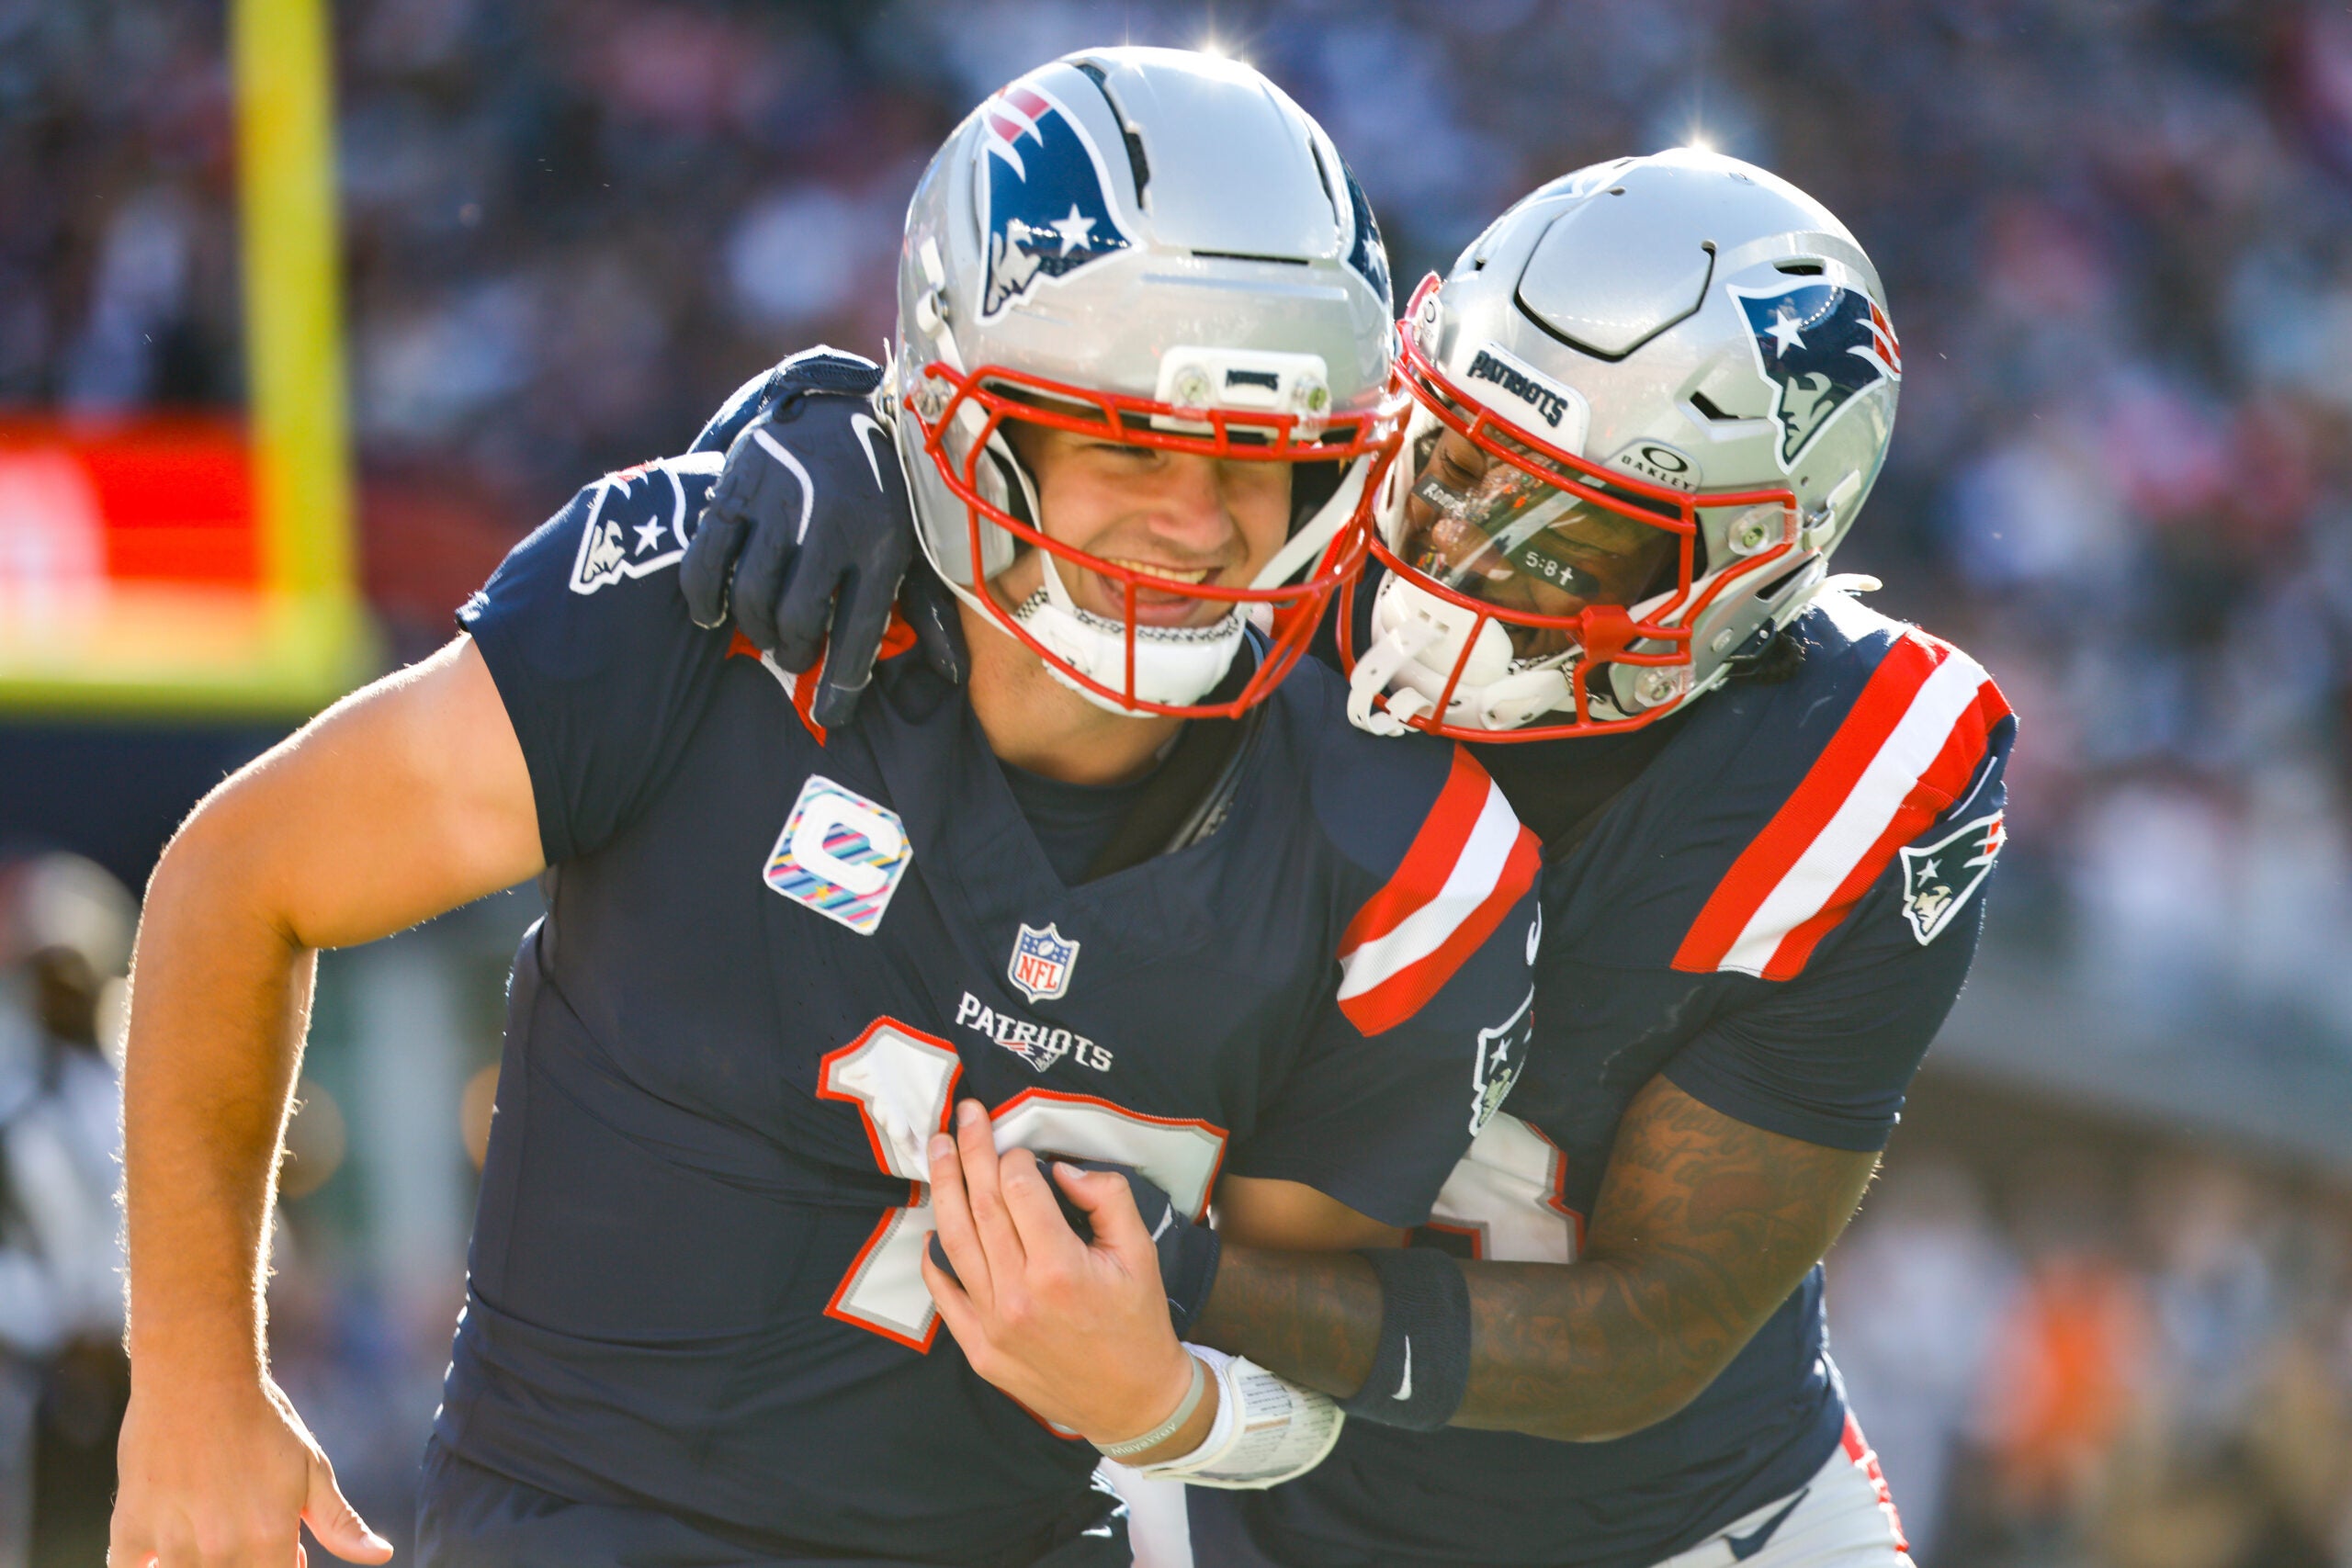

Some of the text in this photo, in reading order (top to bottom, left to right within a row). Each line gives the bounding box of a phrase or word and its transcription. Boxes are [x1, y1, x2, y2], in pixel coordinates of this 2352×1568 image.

[1466, 349, 1569, 429] PATRIOTS
[1621, 455, 1694, 491] OAKLEY
[789, 793, 902, 896] C
[1017, 954, 1057, 989] NFL
[955, 990, 1114, 1073] PATRIOTS
